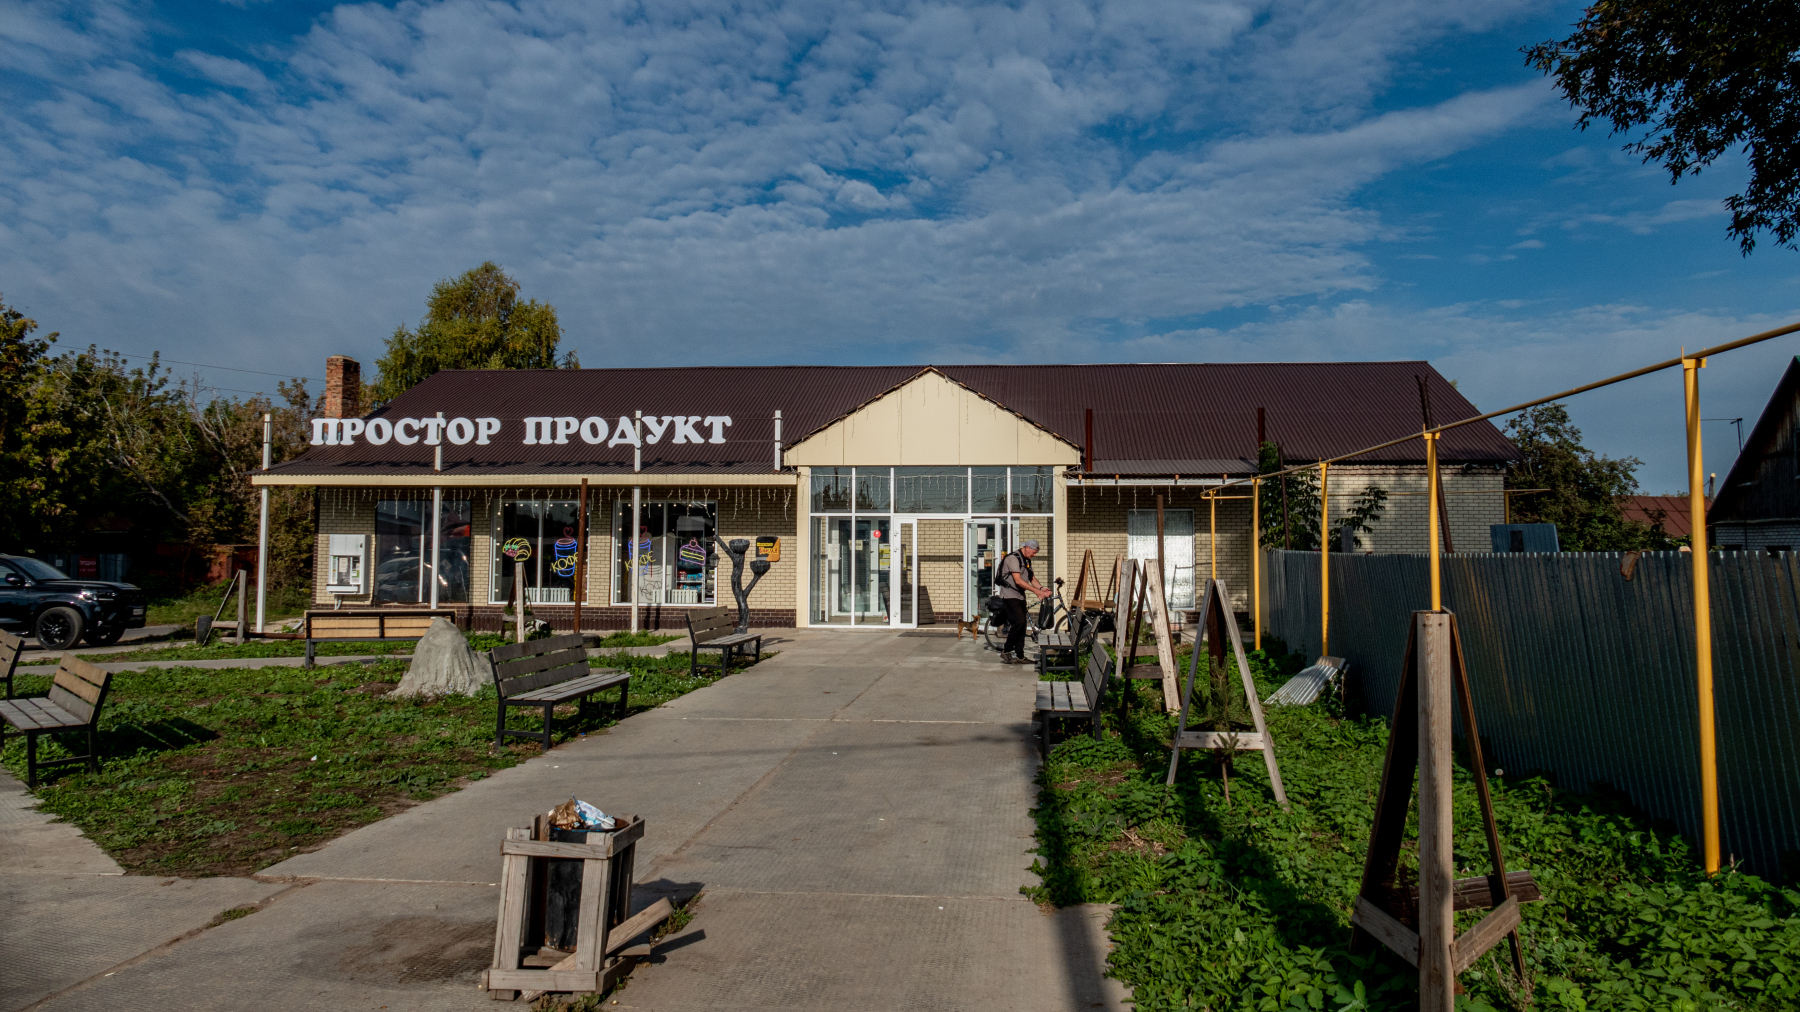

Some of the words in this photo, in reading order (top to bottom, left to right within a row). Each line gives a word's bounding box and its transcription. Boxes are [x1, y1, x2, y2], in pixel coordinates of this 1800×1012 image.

[310, 417, 501, 446] ПРОСТОР
[523, 416, 732, 448] ПРОДУКТ
[624, 551, 656, 572] КФЕ
